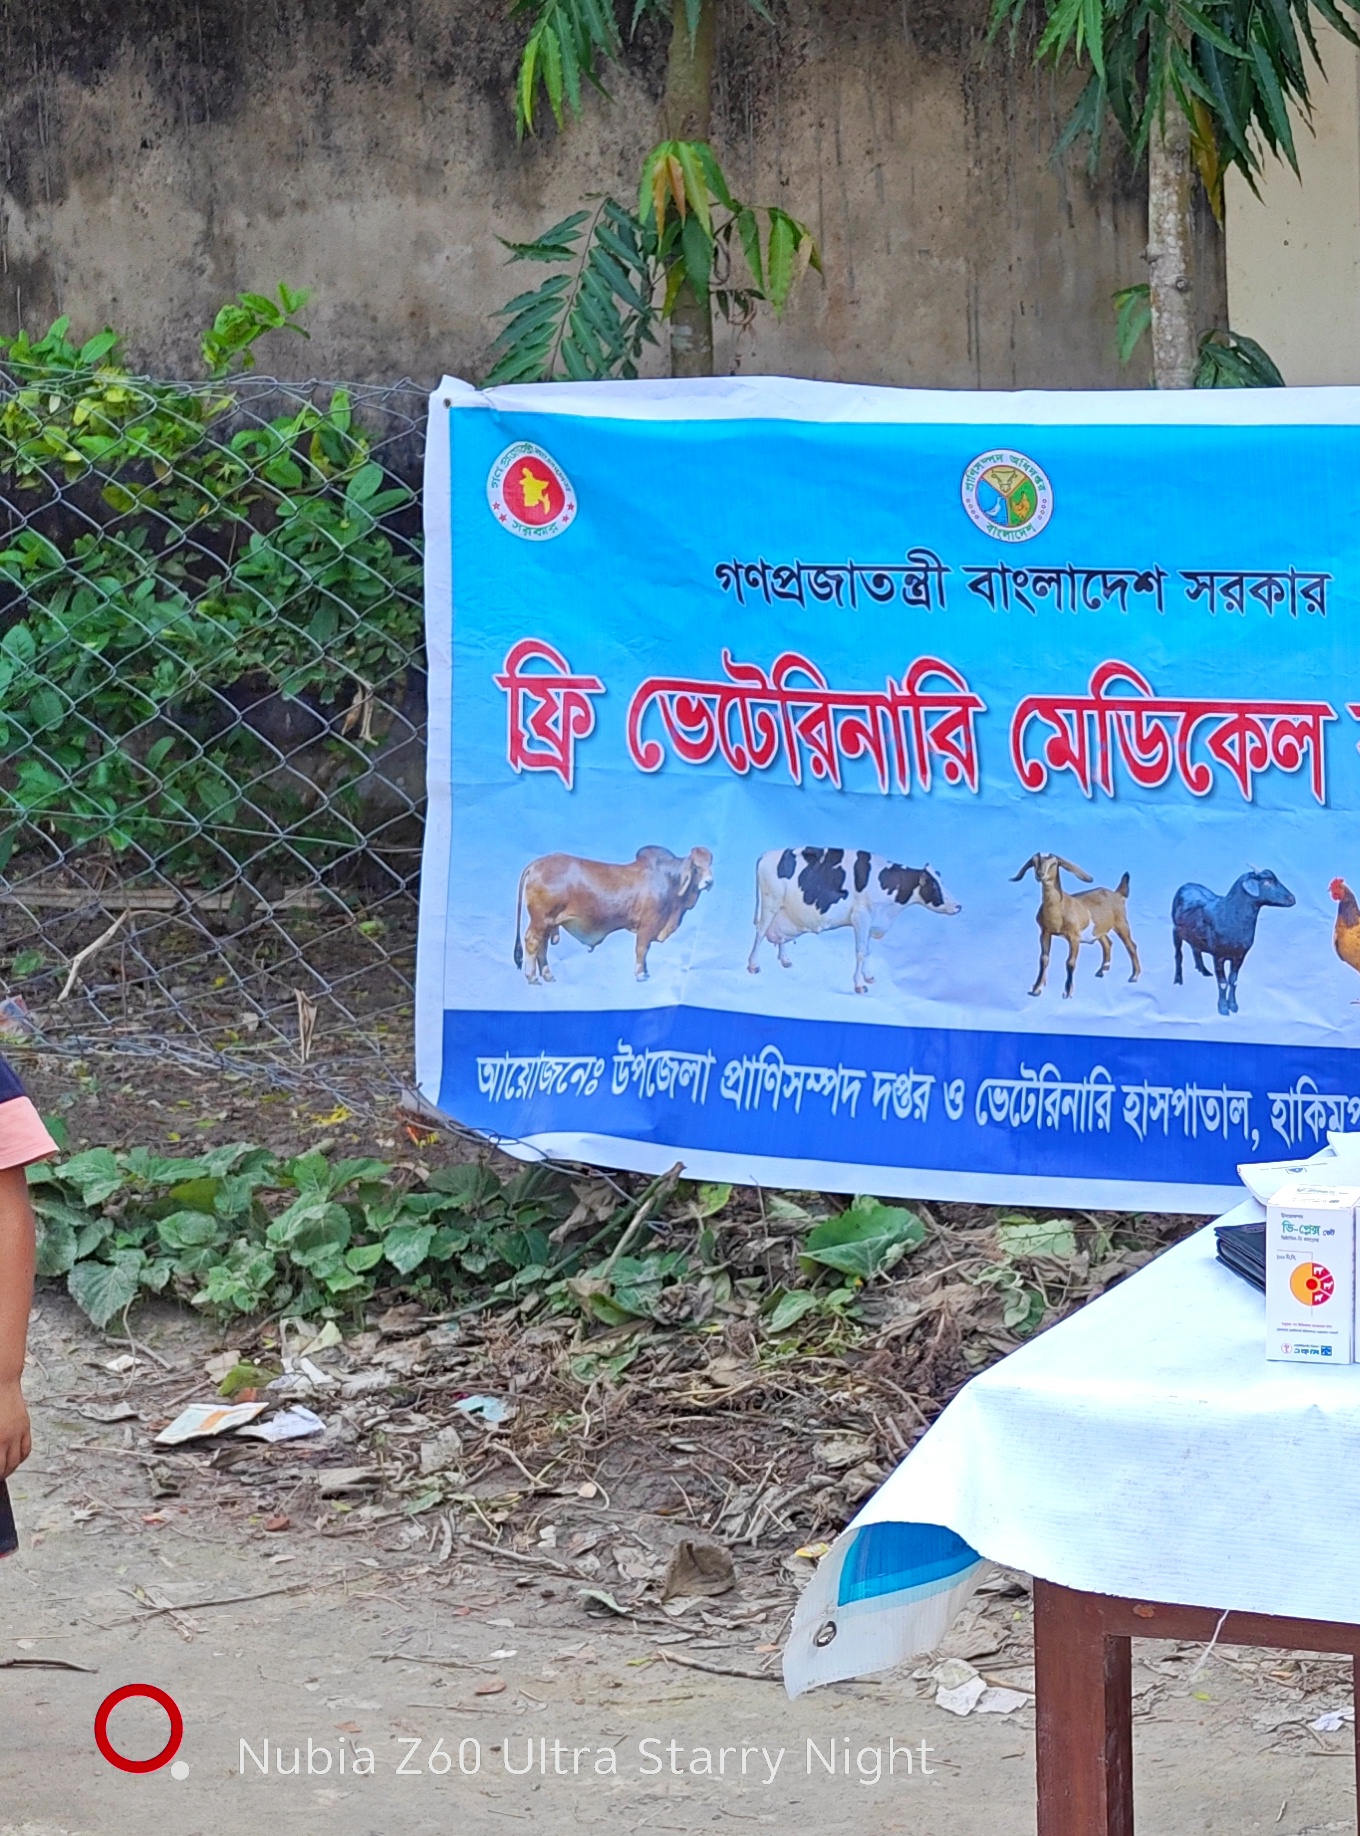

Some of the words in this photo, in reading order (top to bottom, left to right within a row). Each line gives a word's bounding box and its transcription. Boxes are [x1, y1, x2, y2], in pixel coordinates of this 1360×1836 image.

[986, 522, 1036, 540] বাংলাদেশ
[716, 547, 950, 612] গণপ্রজাতন্ত্রী
[967, 562, 1166, 615] বাংলাদেশ
[1186, 566, 1332, 618] সরকার
[493, 637, 605, 791] ফ্রি
[626, 647, 986, 796] ভেটেরিনারি
[1011, 659, 1336, 806] মেডিকেল
[476, 1051, 606, 1104] আয়োজনেঃ
[611, 1037, 715, 1106] উপজেলা
[720, 1044, 866, 1118] প্রাণিসম্পদ
[871, 1067, 936, 1123] দপ্তর
[943, 1081, 965, 1122] ও
[975, 1062, 1116, 1134] ভেটেরিনারি
[1122, 1079, 1260, 1152] হাসপাতাল,
